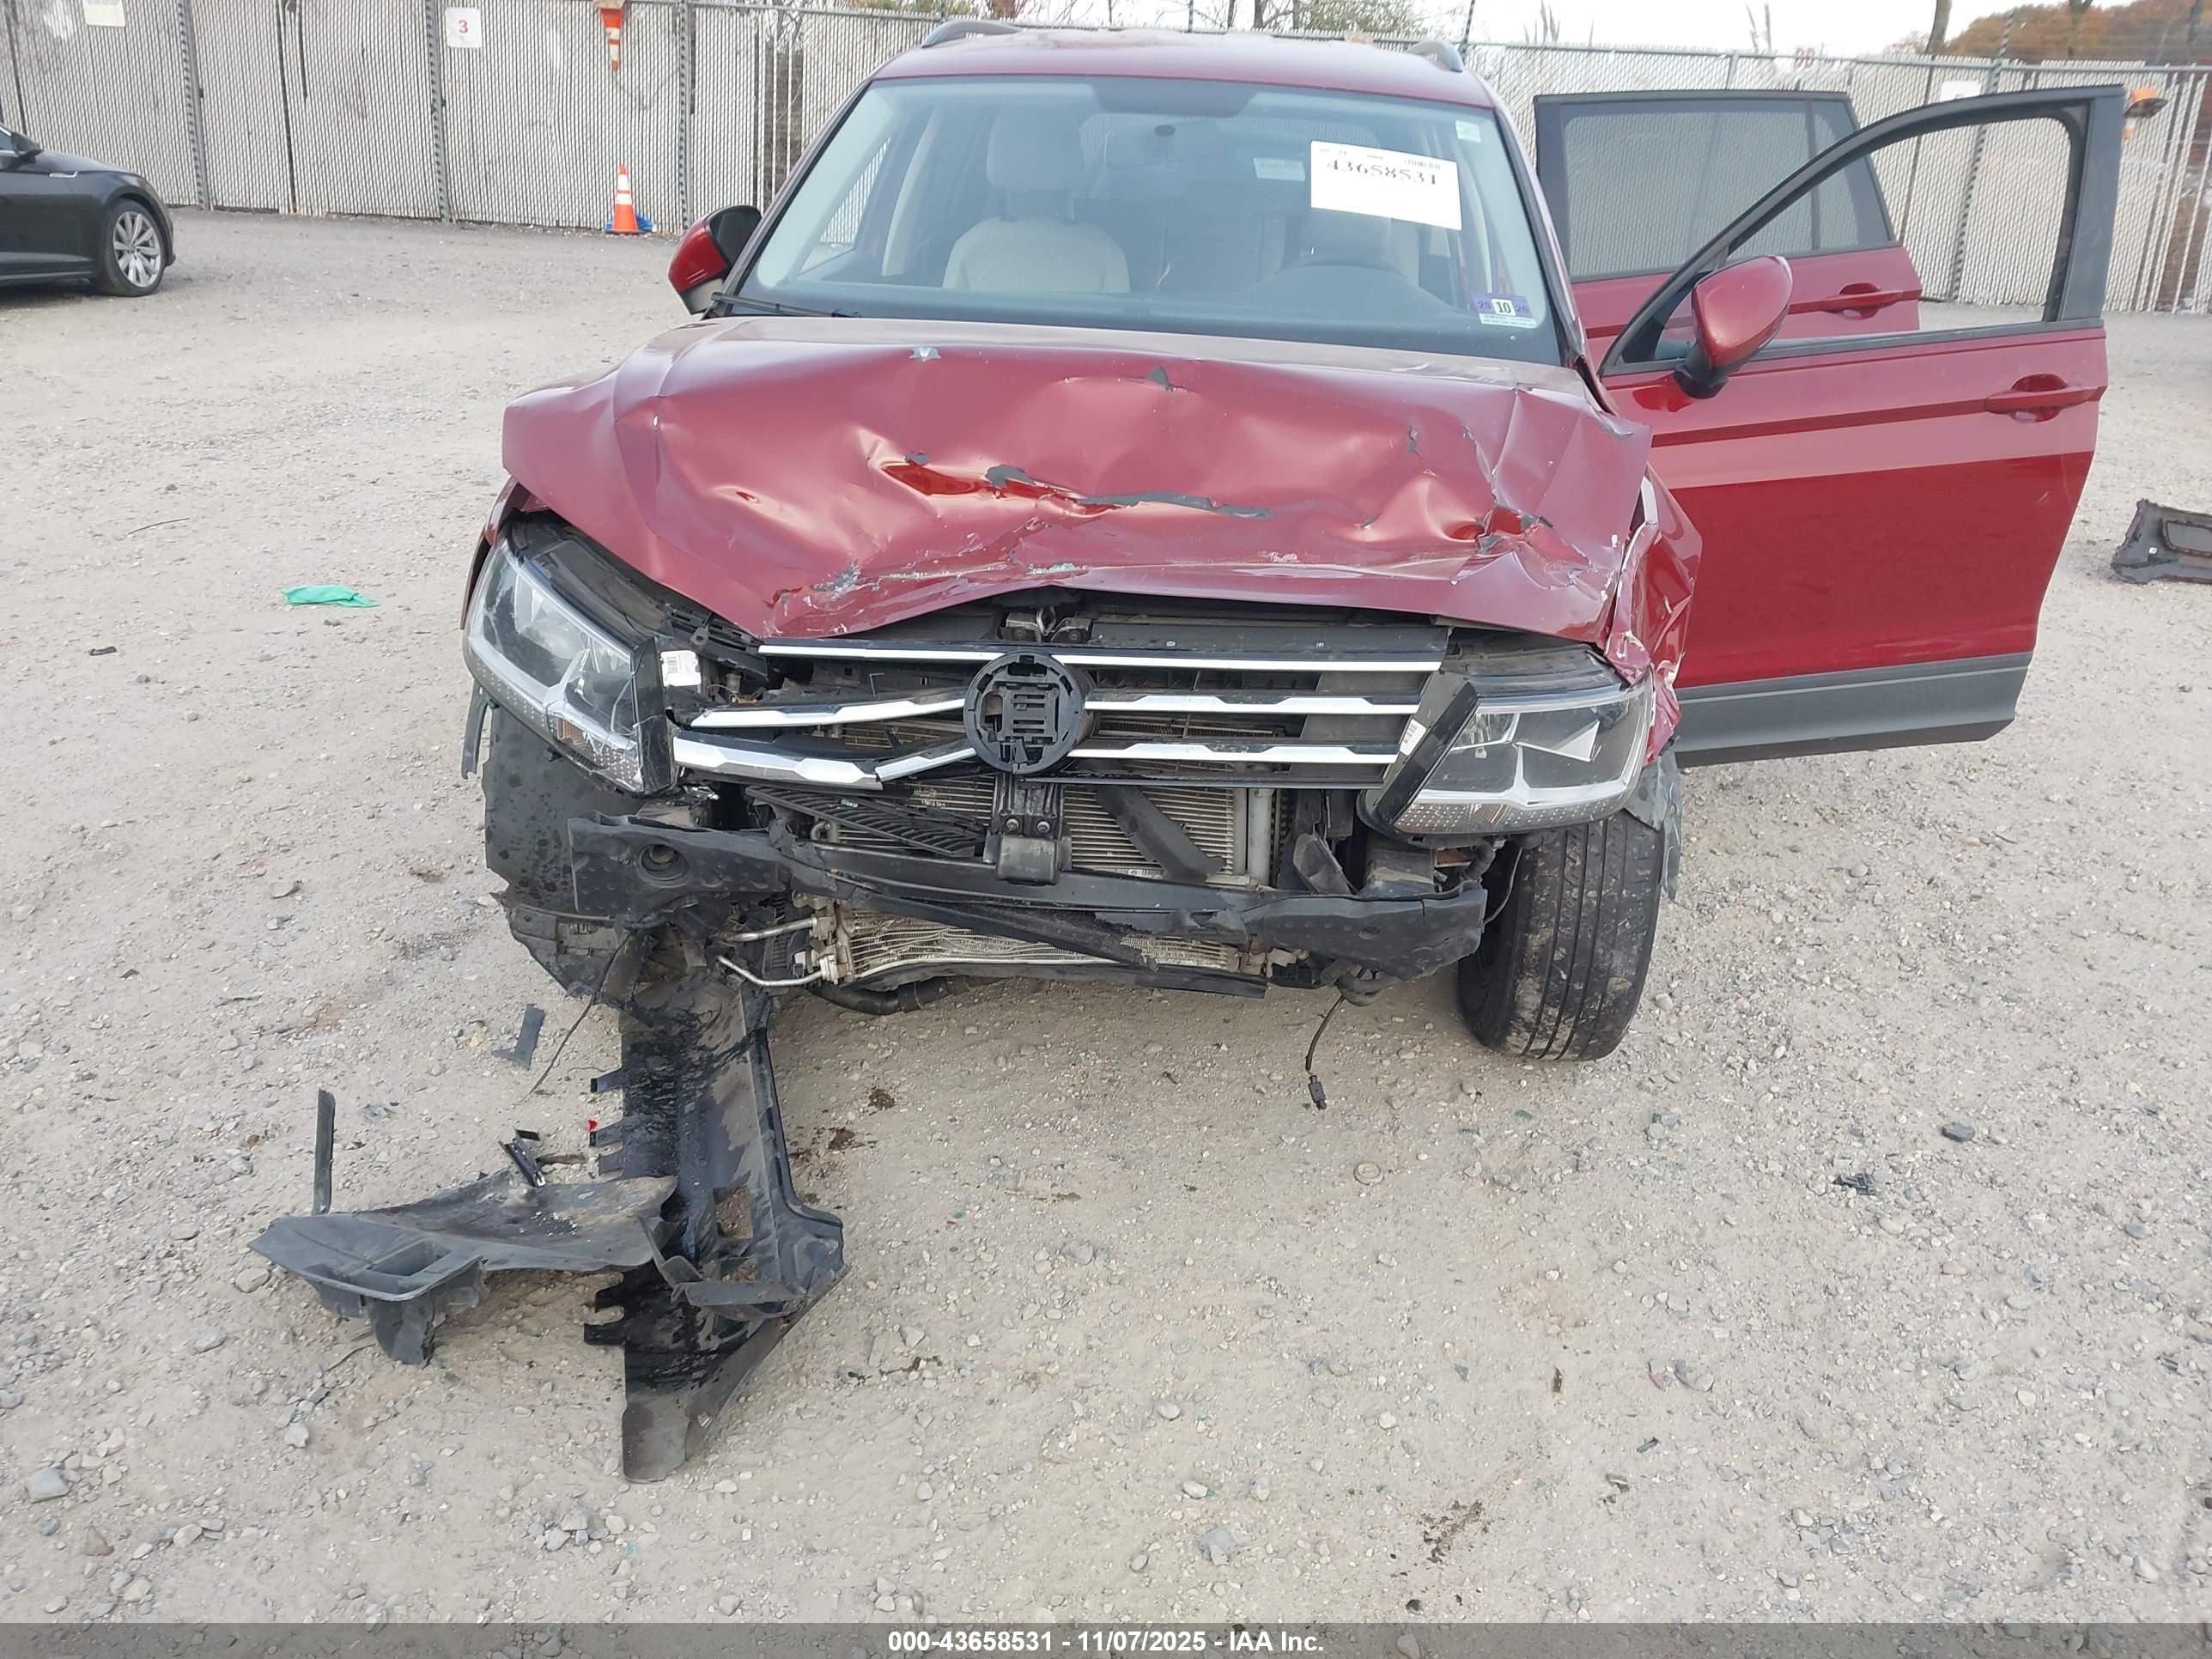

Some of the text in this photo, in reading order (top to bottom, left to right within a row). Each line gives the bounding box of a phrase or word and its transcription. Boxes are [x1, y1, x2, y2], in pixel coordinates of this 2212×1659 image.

[459, 20, 469, 33] 3
[1327, 160, 1436, 185] 43658531
[1496, 301, 1511, 314] 10
